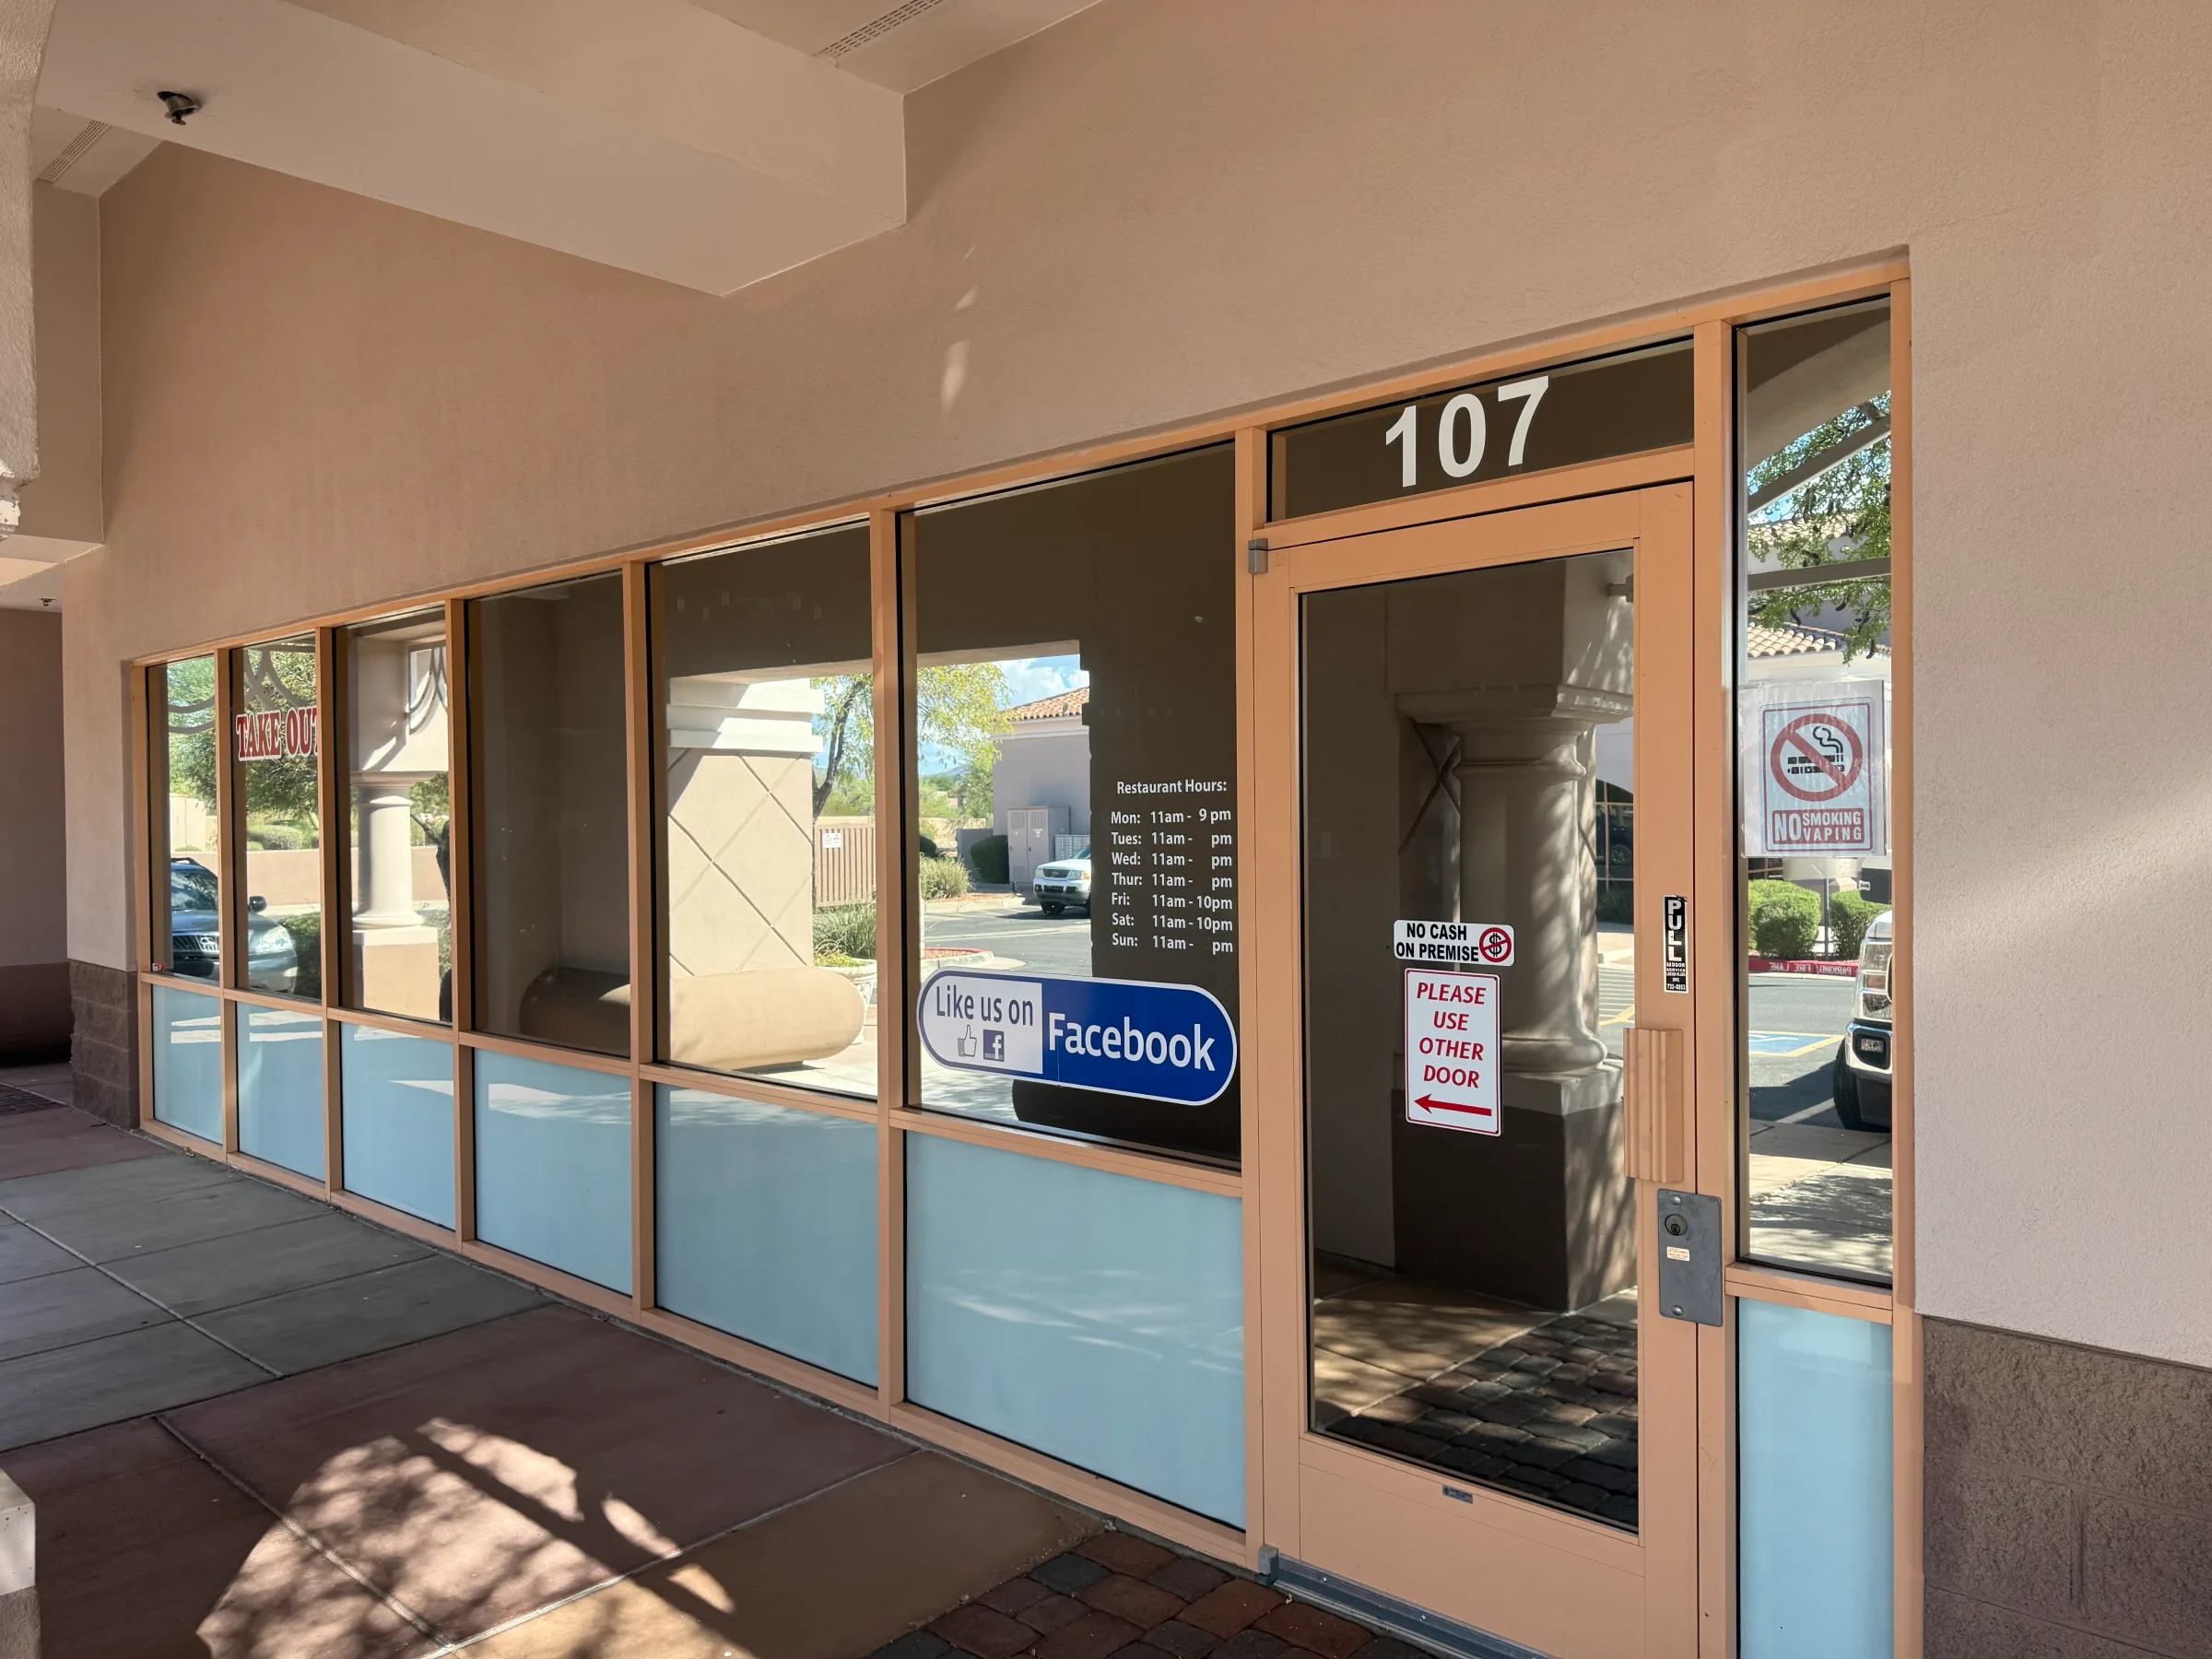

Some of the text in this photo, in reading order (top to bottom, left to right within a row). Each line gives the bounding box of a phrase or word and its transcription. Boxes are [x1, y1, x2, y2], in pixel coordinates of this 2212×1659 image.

[1385, 375, 1549, 488] 107
[236, 710, 282, 761] TAKE
[1117, 778, 1227, 794] Restaurant Hours:
[1111, 810, 1141, 824] Mon:
[1150, 810, 1184, 824] 11am
[1198, 807, 1207, 822] 9
[1210, 809, 1231, 825] pm
[1774, 811, 1861, 841] NO SMOKING
[1111, 831, 1142, 845] Tues:
[1151, 831, 1185, 845] 11am
[1211, 834, 1232, 849] pm
[1803, 827, 1862, 841] VAPING
[1111, 851, 1141, 865] Wed:
[1151, 853, 1185, 866] 11am
[1211, 855, 1232, 870] pm
[1111, 871, 1143, 886] Thur:
[1152, 873, 1186, 887] 11am
[1211, 877, 1233, 891] pm
[1112, 891, 1130, 906] Fri:
[1152, 893, 1186, 908] 11am
[1196, 895, 1233, 912] 10pm
[1112, 912, 1135, 926] Sat:
[1152, 914, 1186, 929] 11am
[1196, 916, 1233, 934] 10pm
[1406, 923, 1467, 941] NO CASH
[1667, 900, 1683, 962] PULL
[1112, 932, 1138, 947] Sun:
[1152, 935, 1186, 950] 11am
[1212, 941, 1233, 956] pm
[1395, 942, 1479, 962] ON PREMISE
[1417, 982, 1487, 1005] PLEASE
[935, 985, 1033, 1026] Like us on
[1433, 1010, 1470, 1031] USE
[1048, 1012, 1216, 1071] Facebook
[1418, 1037, 1484, 1062] OTHER
[1423, 1065, 1480, 1089] DOOR
